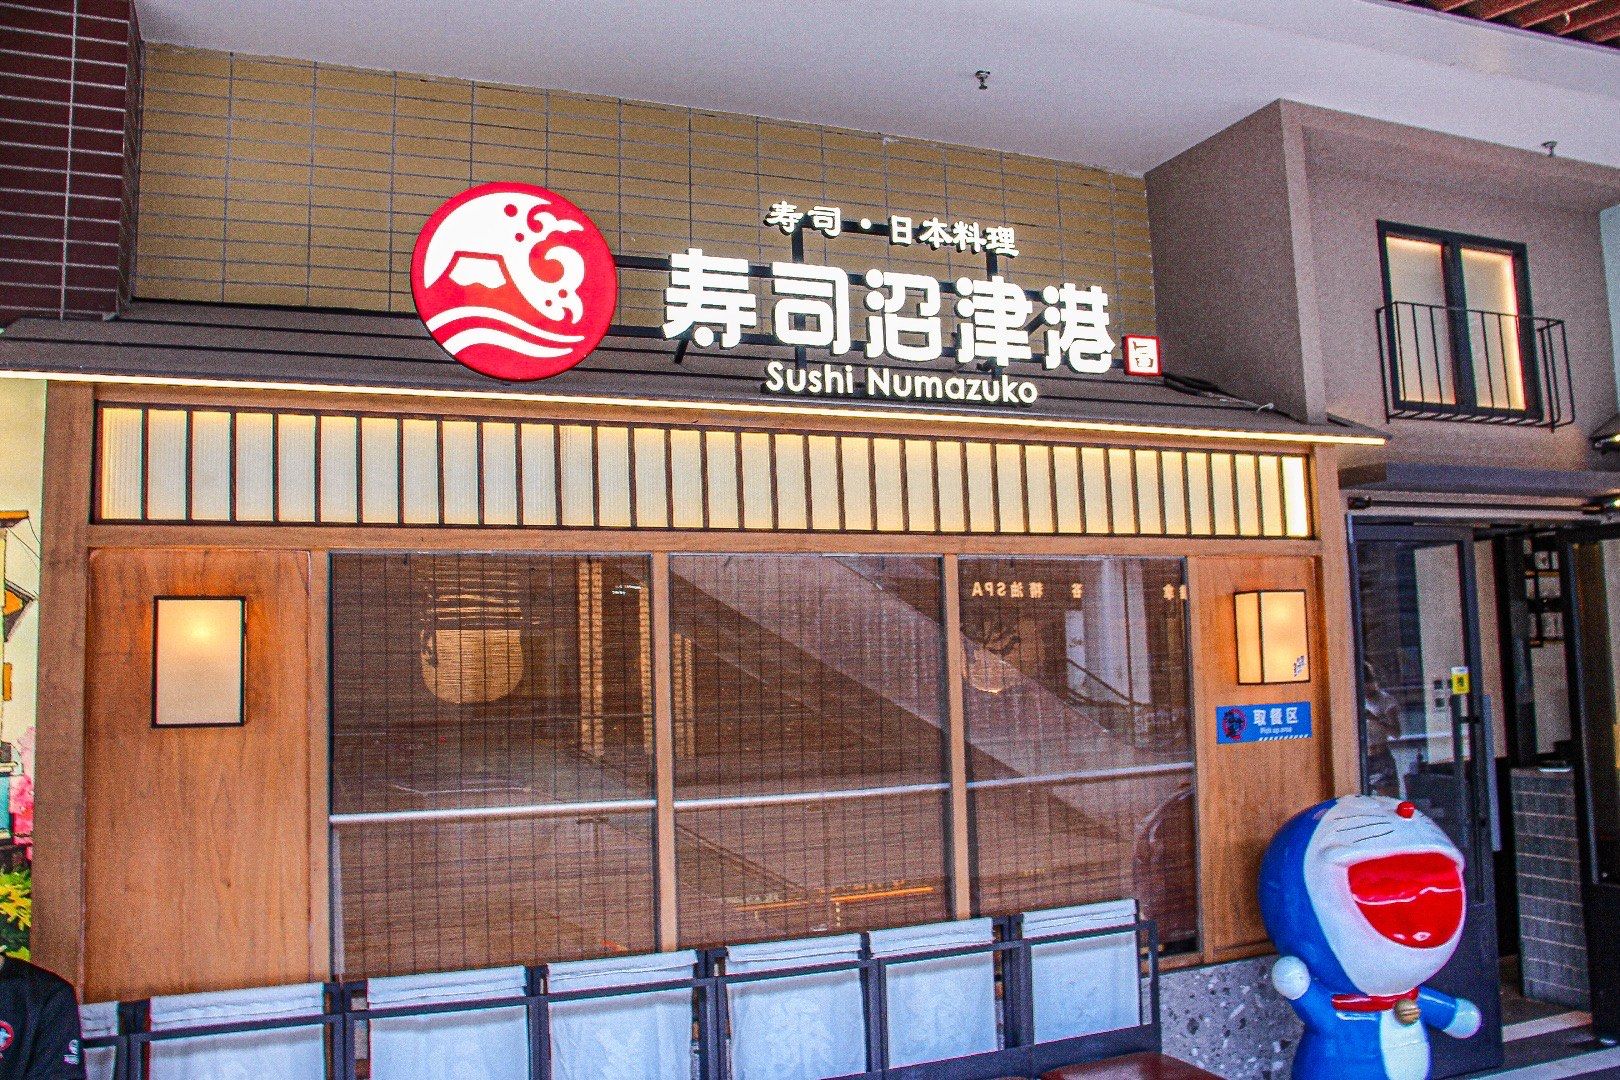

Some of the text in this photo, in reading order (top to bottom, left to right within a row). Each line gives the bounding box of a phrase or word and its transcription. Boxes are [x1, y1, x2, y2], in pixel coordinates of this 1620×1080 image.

[662, 247, 1116, 374] 寿司沼津港
[765, 361, 1038, 405] Sushi Numazuko
